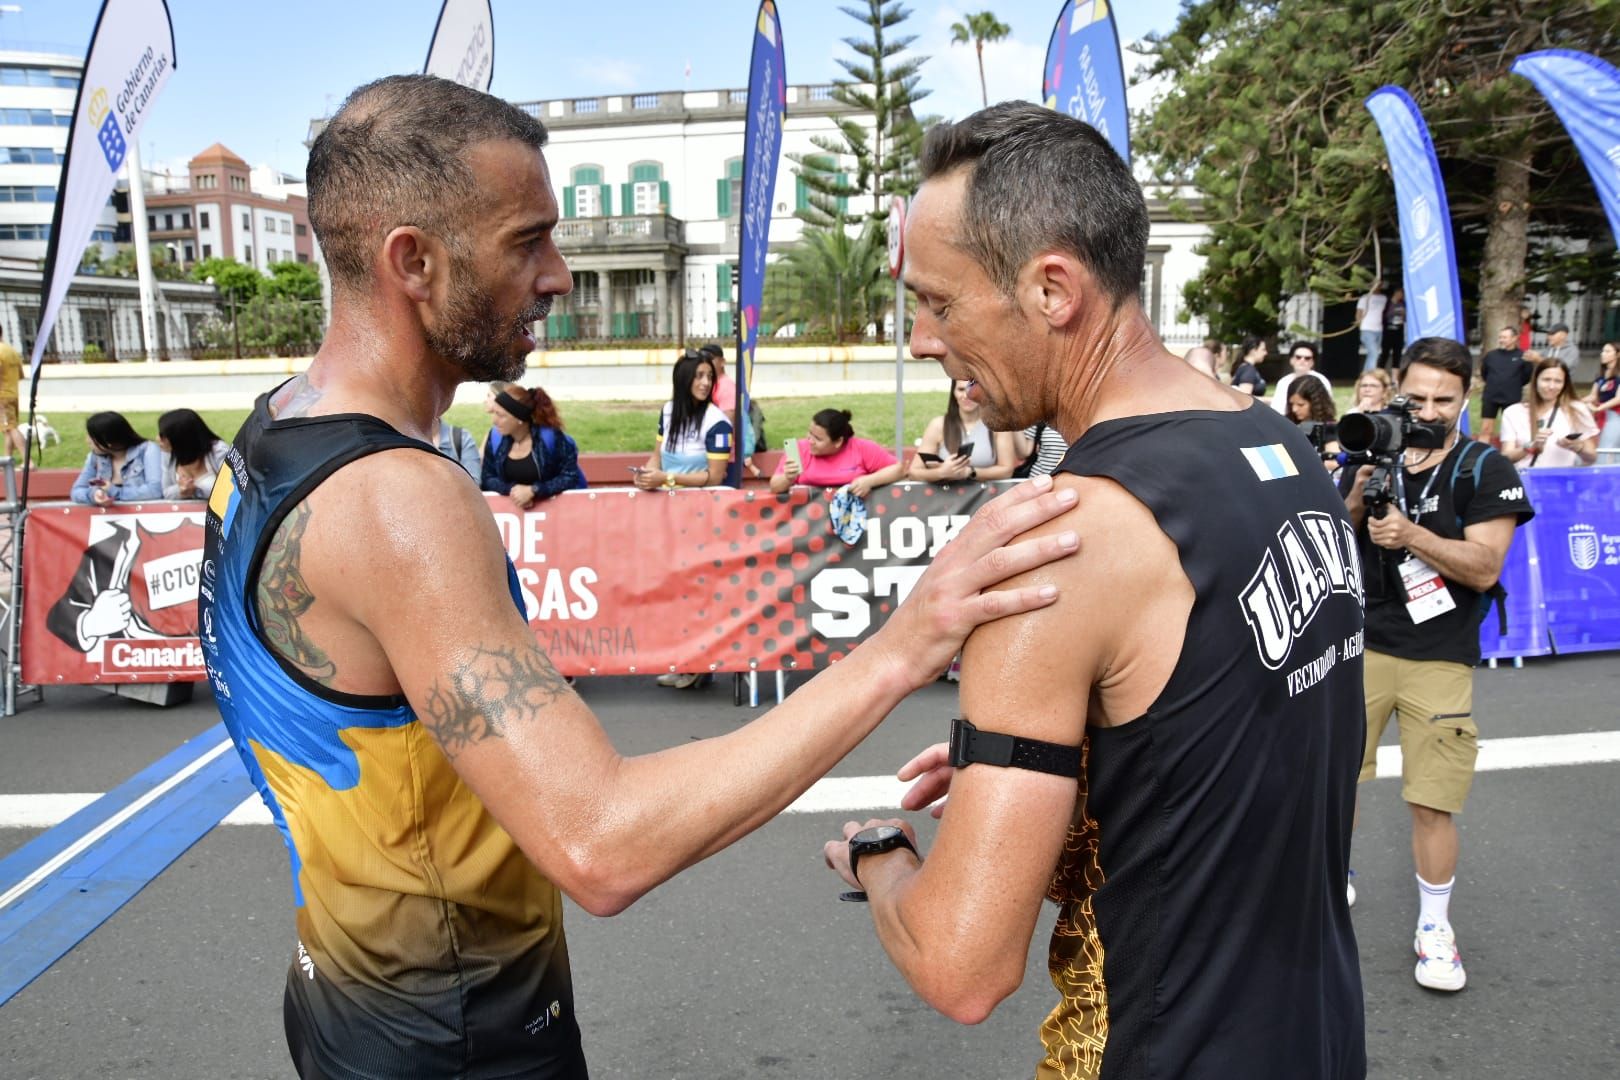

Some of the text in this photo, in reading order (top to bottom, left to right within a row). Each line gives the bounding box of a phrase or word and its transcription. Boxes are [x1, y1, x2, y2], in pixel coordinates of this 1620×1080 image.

[116, 46, 153, 114] Gobierno
[125, 53, 167, 134] de Canarias
[494, 511, 546, 563] DE
[862, 515, 970, 560] 10K
[517, 567, 598, 621] SAS
[811, 565, 929, 638] ST
[111, 642, 205, 668] Canaria
[1286, 644, 1336, 697] VECINDARIO
